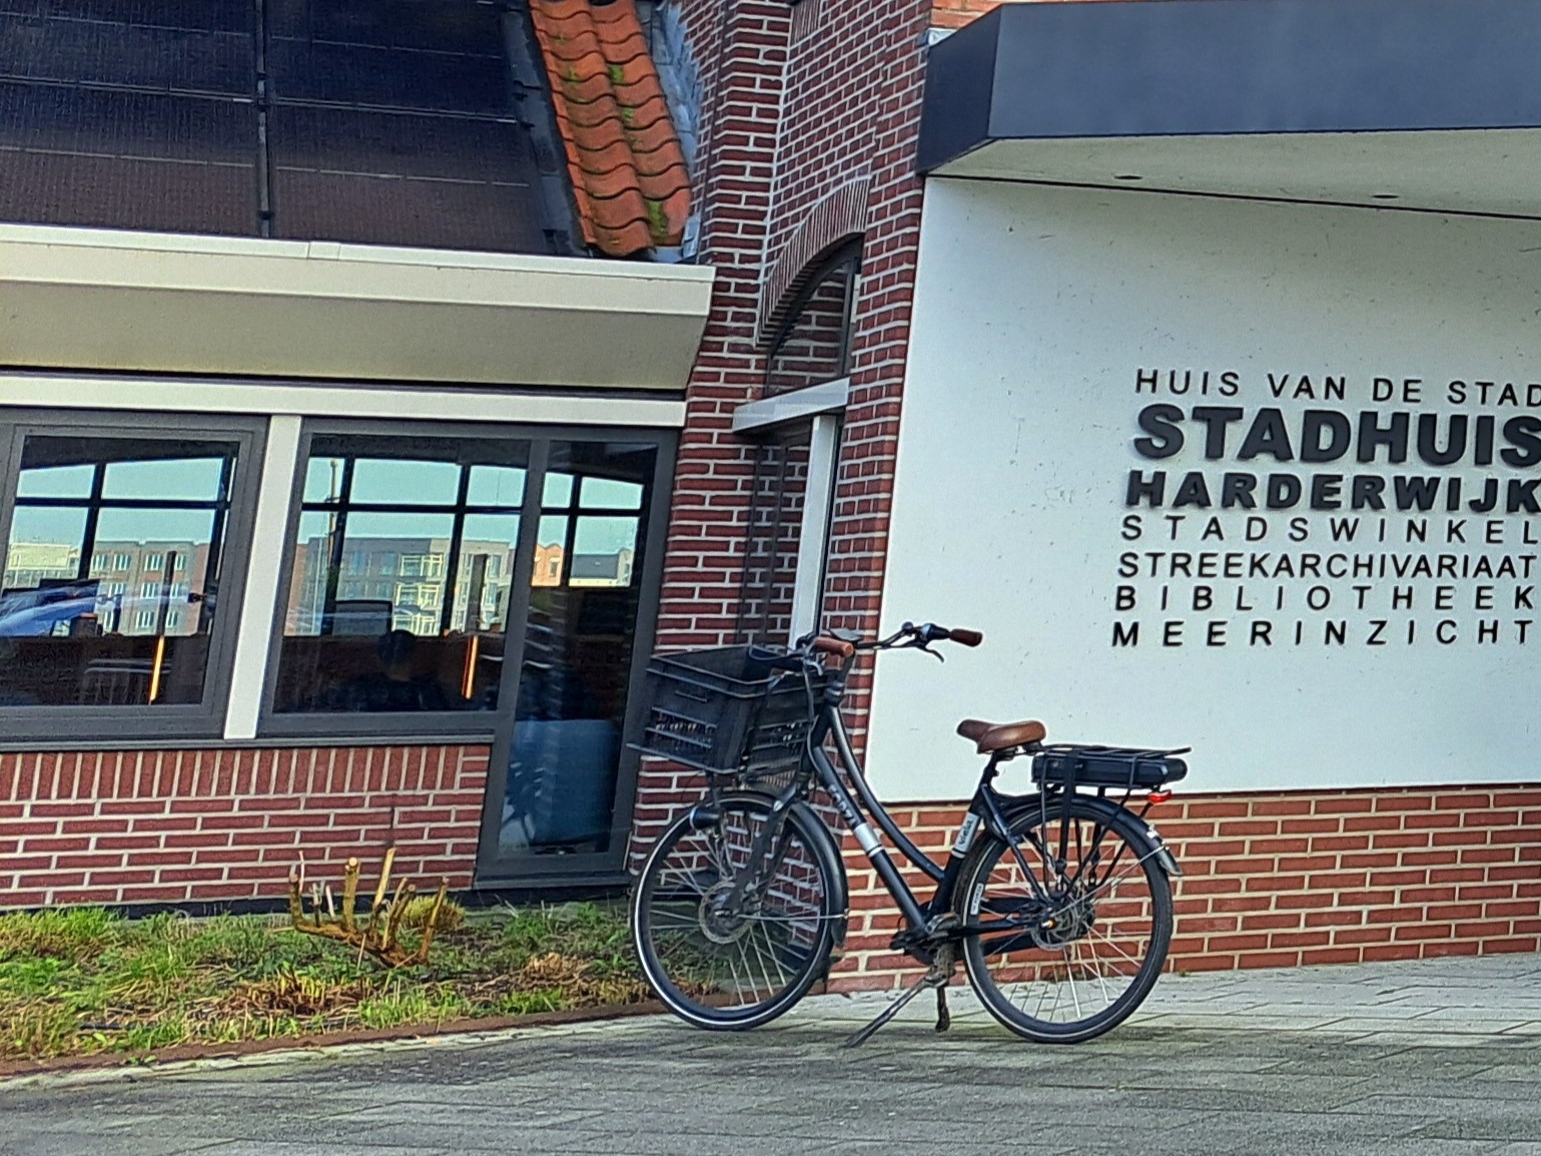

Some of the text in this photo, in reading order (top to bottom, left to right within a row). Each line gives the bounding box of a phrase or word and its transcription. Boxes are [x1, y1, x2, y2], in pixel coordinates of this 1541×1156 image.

[1135, 369, 1239, 397] HUIS
[1268, 373, 1345, 400] VAN
[1372, 378, 1422, 402] DE
[1121, 515, 1539, 544] STADSWINKEL
[1118, 552, 1537, 579] STREEKARCHIVARIAAT
[1114, 585, 1534, 611] BIBLIOTHEEK
[1112, 619, 1532, 647] MEERINZICHT
